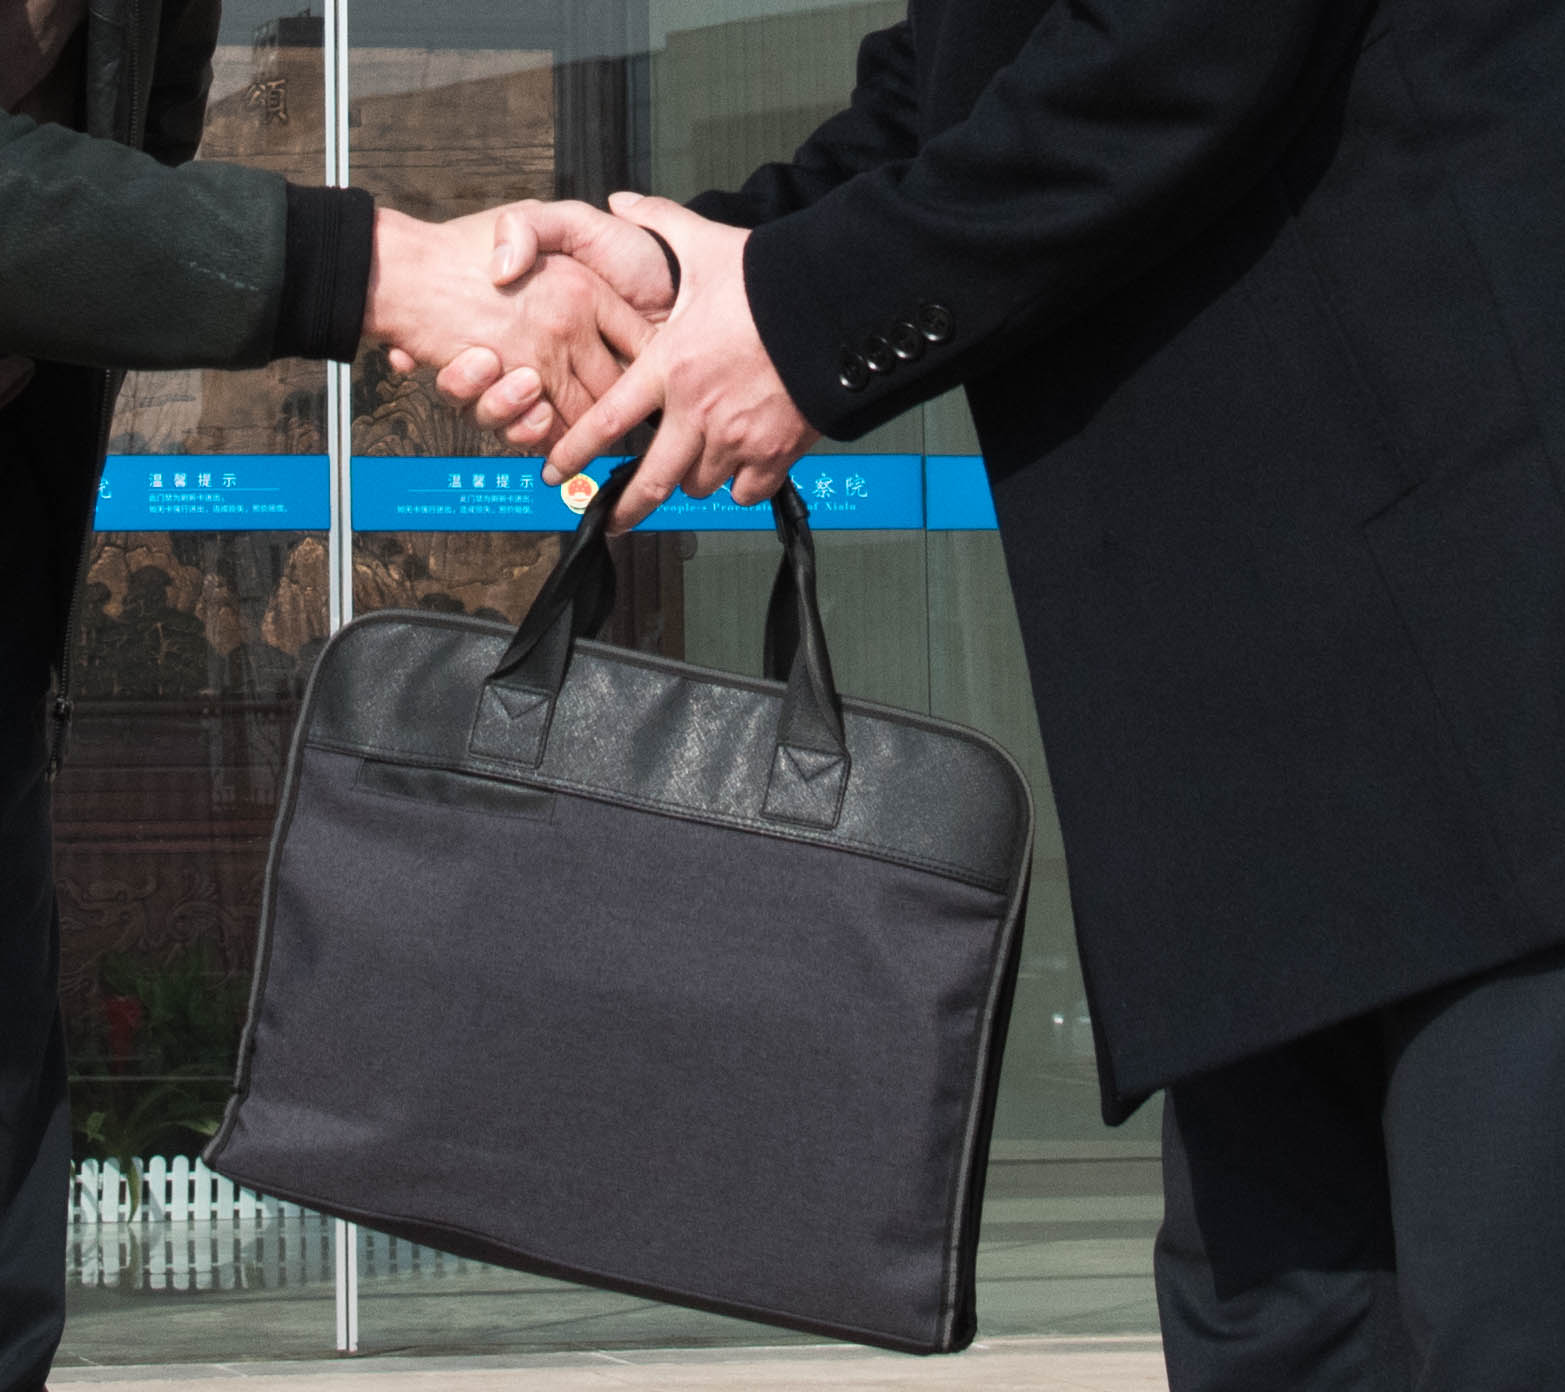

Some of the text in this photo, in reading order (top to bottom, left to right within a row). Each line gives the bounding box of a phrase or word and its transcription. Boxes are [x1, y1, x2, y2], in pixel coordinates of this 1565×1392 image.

[149, 473, 237, 488] 温馨提示
[448, 473, 534, 488] 温馨提示
